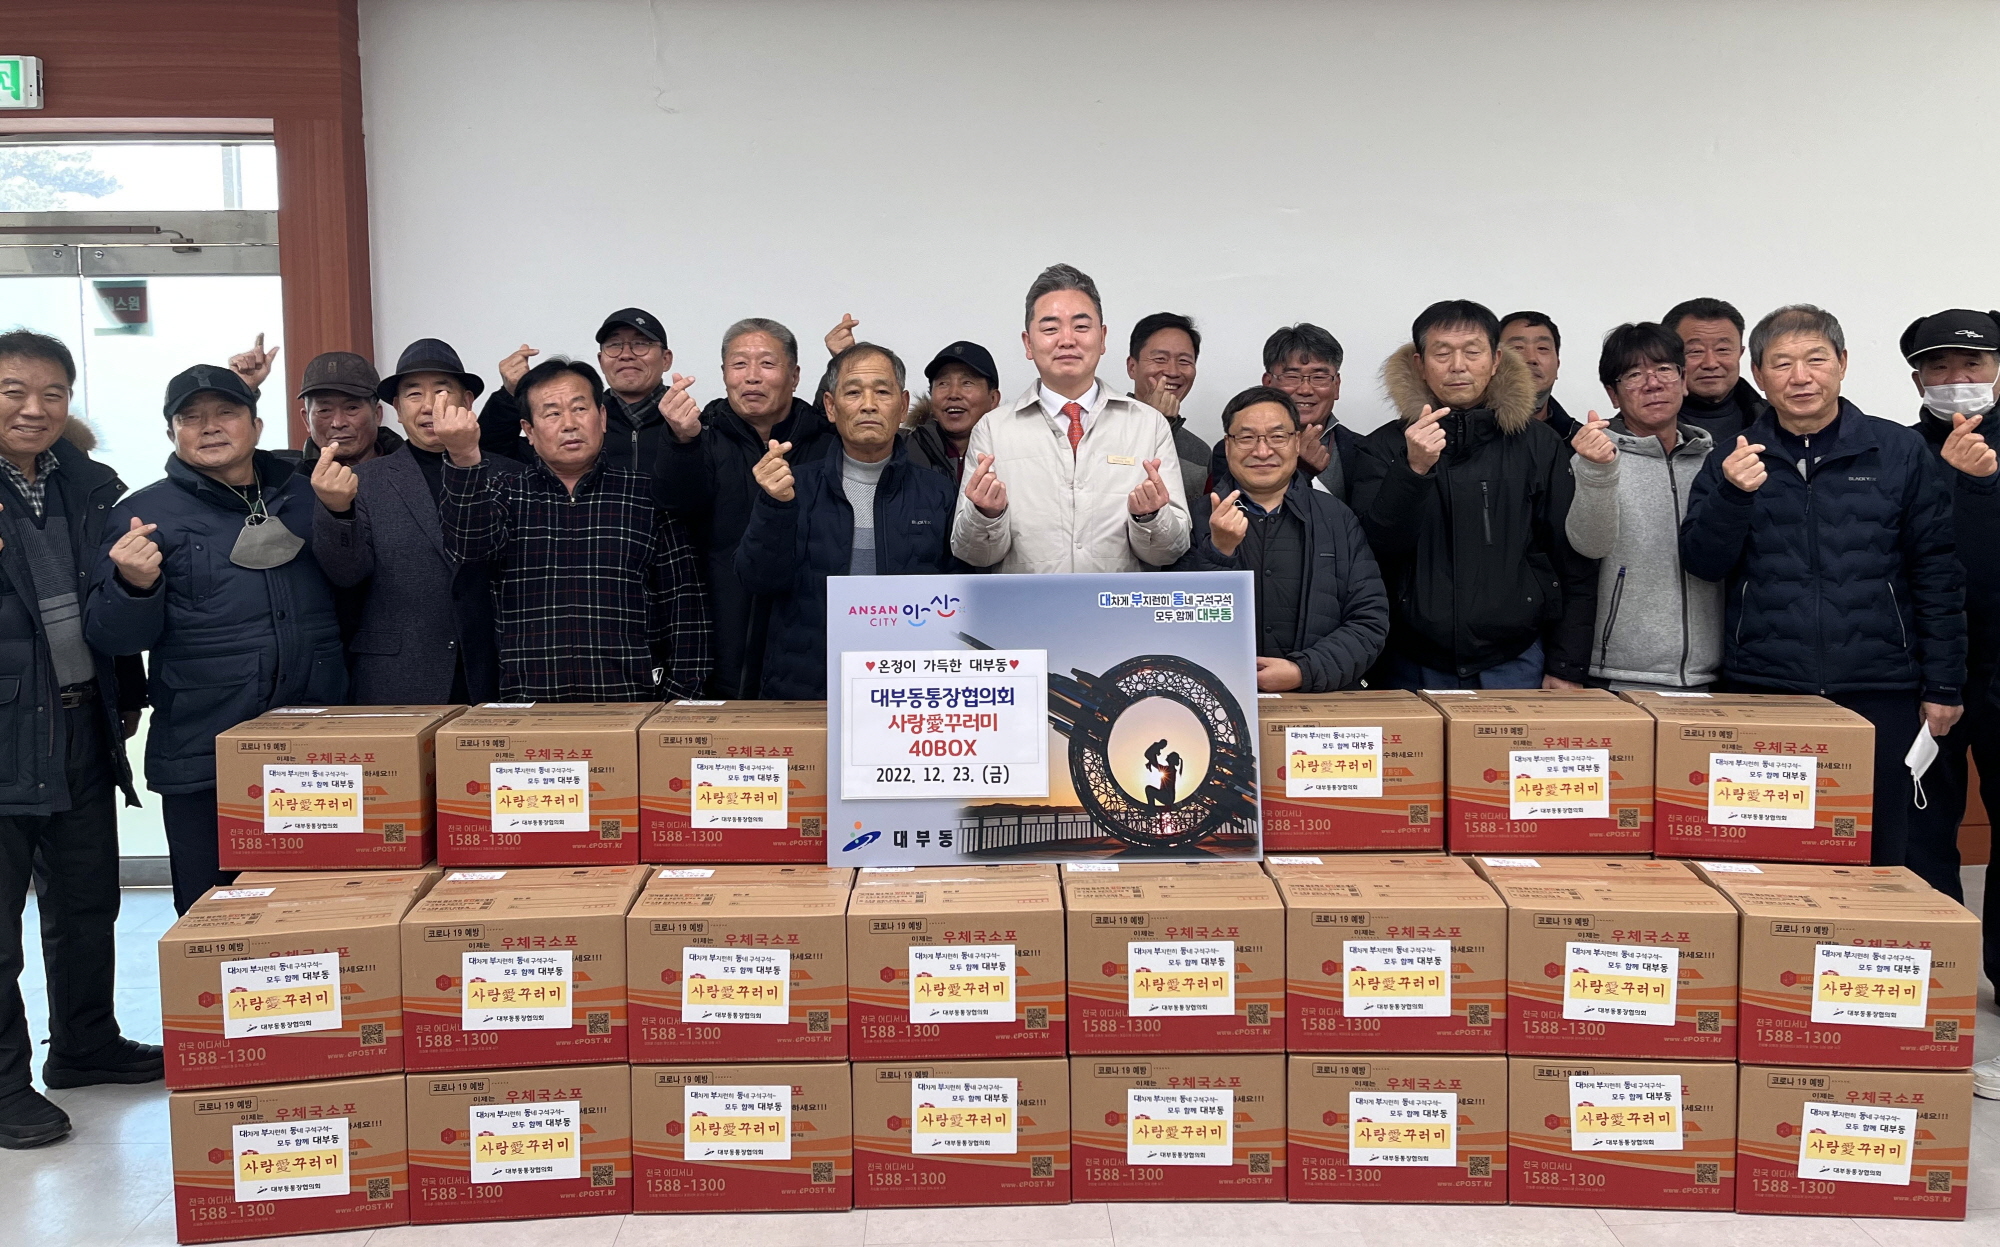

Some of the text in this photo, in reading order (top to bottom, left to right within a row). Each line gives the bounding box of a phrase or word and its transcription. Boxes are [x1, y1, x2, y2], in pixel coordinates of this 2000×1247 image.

[1100, 592, 1232, 606] 대차게 부지런히 동네 구석구석
[848, 605, 898, 615] ANSAN
[1156, 608, 1232, 621] 모두 함께 대부동
[870, 618, 897, 626] CITY
[878, 658, 1008, 674] 온정이 가득한 대부동
[870, 686, 1015, 708] 대부동통장협의회
[888, 713, 998, 734] 사랑愛꾸러미
[1683, 728, 1732, 738] 코로나 19 예방
[908, 739, 977, 757] 40BOX
[1543, 737, 1612, 748] 우체국소포
[1753, 741, 1829, 755] 우체국소포
[306, 752, 375, 764] 우체국소포
[524, 749, 593, 760] 우체국소포
[726, 746, 794, 758] 우체국소포
[876, 765, 1010, 784] 2022. 12. 23. (금)
[1262, 819, 1330, 831] 588-1300
[1464, 822, 1538, 833] 1588-1300
[1667, 824, 1746, 838] 1588-1300
[230, 837, 304, 849] 1588-1300
[448, 834, 521, 846] 1588-1300
[651, 830, 722, 842] 1588-1300
[873, 921, 922, 930] 코로나 19 예방
[1095, 916, 1144, 924] 코로나 19 예방
[1315, 915, 1365, 924] 코로나 19 예방
[1537, 916, 1590, 926] 코로나 19 예방
[428, 928, 479, 938] 코로나 19 예방
[654, 923, 703, 932] 코로나 19 예방
[1165, 927, 1239, 939] 우체국소포
[1386, 926, 1461, 939] 우체국소포
[1775, 924, 1829, 935] 코로나 19 예방
[501, 935, 578, 949] 우체국소포
[725, 934, 799, 945] 우체국소포
[943, 930, 1017, 943] 우체국소포
[1611, 929, 1690, 944] 우체국소포
[189, 942, 244, 954] 코로나 19 예방
[982, 962, 1006, 971] 대부동
[302, 969, 330, 981] 대부동
[918, 982, 1004, 997] 사랑愛꾸러미
[1137, 977, 1223, 992] 사랑愛꾸러미
[1352, 976, 1439, 991] 사랑愛꾸러미
[1573, 978, 1665, 998] 사랑愛꾸러미
[1822, 980, 1916, 1000] 사랑愛꾸러미
[471, 987, 561, 1003] 사랑愛꾸러미
[691, 984, 778, 1000] 사랑愛꾸러미
[232, 990, 328, 1013] 사랑愛꾸러미
[861, 1024, 940, 1038] 1588-1300
[1083, 1019, 1161, 1032] 1588-1300
[1301, 1018, 1381, 1031] 1588-1300
[1522, 1020, 1606, 1036] 1588-1300
[416, 1032, 498, 1048] 1588-1300
[641, 1027, 721, 1040] 1588-1300
[1756, 1029, 1841, 1044] 1588-1300
[178, 1047, 266, 1066] 1588-1300
[1098, 1066, 1147, 1074] 코로나 19 예방
[1316, 1066, 1366, 1075] 코로나 19 예방
[433, 1081, 484, 1092] 코로나 19 예방
[1168, 1077, 1241, 1088] 우체국소포
[1387, 1077, 1462, 1091] 우체국소포
[1771, 1077, 1824, 1087] 코로나 19 예방
[506, 1088, 582, 1103] 우체국소포
[1845, 1090, 1925, 1106] 우체국소포
[198, 1099, 252, 1112] 코로나 19 예방
[276, 1103, 356, 1120] 우체국소포
[920, 1113, 1006, 1127] 사랑愛꾸러미
[1579, 1112, 1670, 1126] 사랑愛꾸러미
[693, 1122, 780, 1136] 사랑愛꾸러미
[1136, 1124, 1222, 1140] 사랑愛꾸러미
[1358, 1127, 1445, 1143] 사랑愛꾸러미
[277, 1139, 291, 1147] 모두
[312, 1134, 339, 1145] 대부동
[480, 1138, 569, 1156] 사랑愛꾸러미
[1809, 1138, 1902, 1159] 사랑愛꾸러미
[243, 1154, 337, 1175] 사랑愛꾸러미
[868, 1172, 946, 1186] 1588-1300
[1085, 1168, 1163, 1181] 1588-1300
[1302, 1168, 1382, 1181] 1588-1300
[1523, 1171, 1605, 1186] 1588-1300
[646, 1178, 725, 1192] 1588-1300
[1752, 1179, 1836, 1194] 1588-1300
[421, 1184, 502, 1201] 1588-1300
[189, 1202, 275, 1222] 1588-1300
